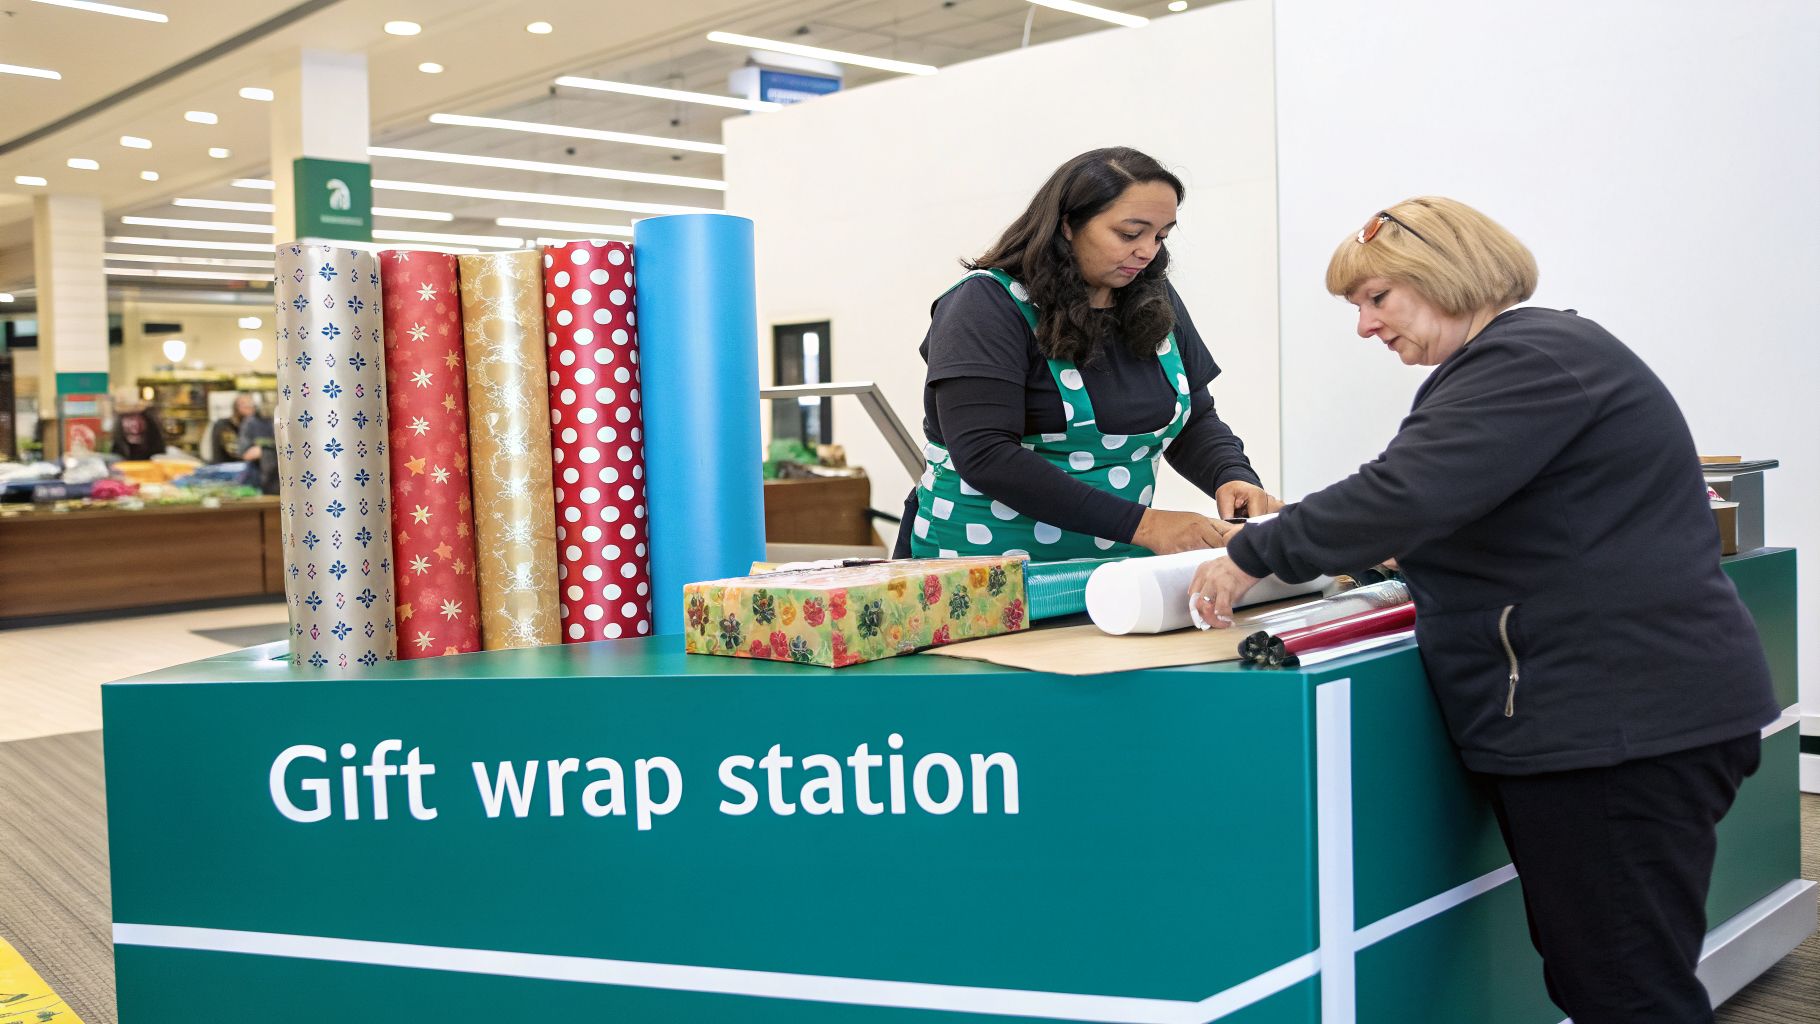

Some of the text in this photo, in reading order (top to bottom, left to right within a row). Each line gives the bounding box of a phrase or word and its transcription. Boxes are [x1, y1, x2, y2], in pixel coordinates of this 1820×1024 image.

[269, 732, 1020, 831] Gift wrap station
